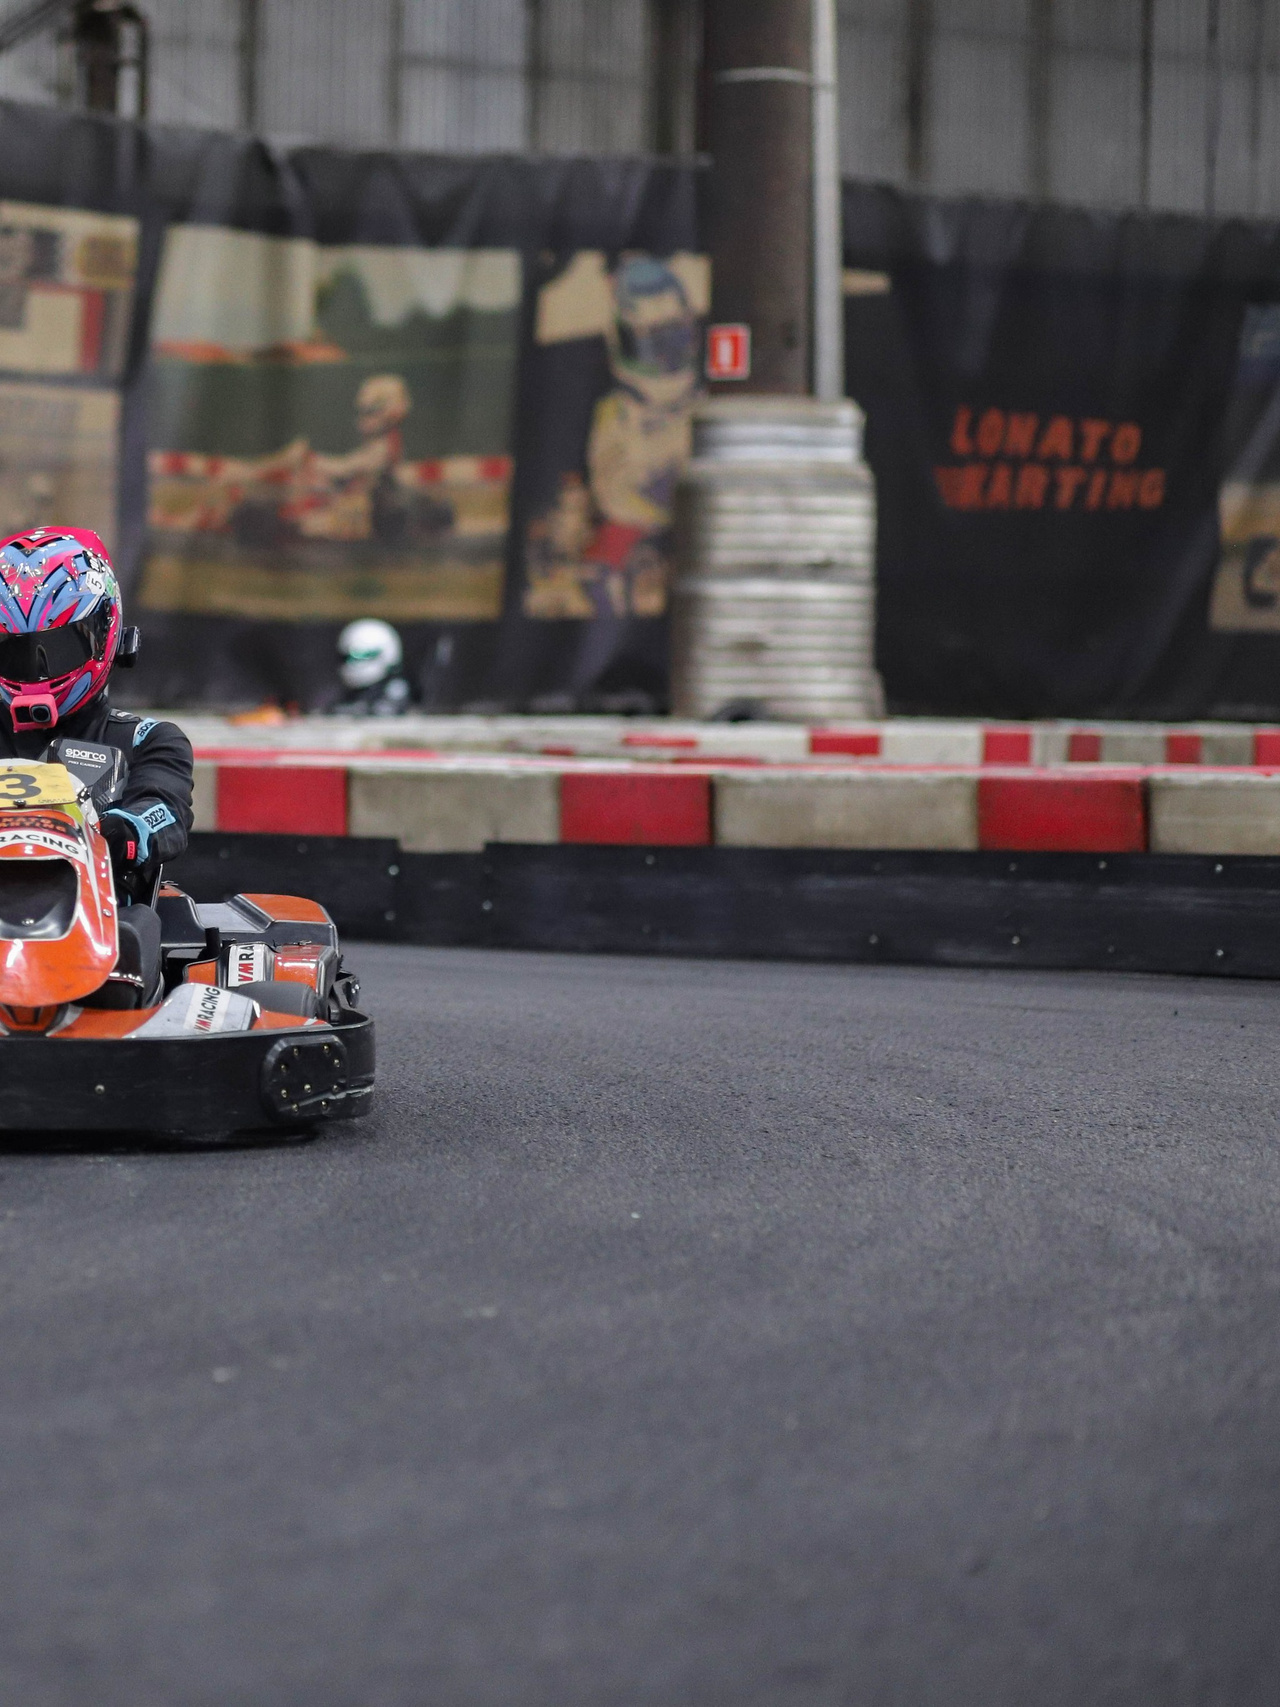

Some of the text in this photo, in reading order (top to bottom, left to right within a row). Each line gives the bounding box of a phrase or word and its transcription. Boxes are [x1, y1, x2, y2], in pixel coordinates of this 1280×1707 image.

[950, 402, 1142, 465] LONATO
[946, 462, 1166, 511] KARTING
[65, 748, 107, 763] sparco
